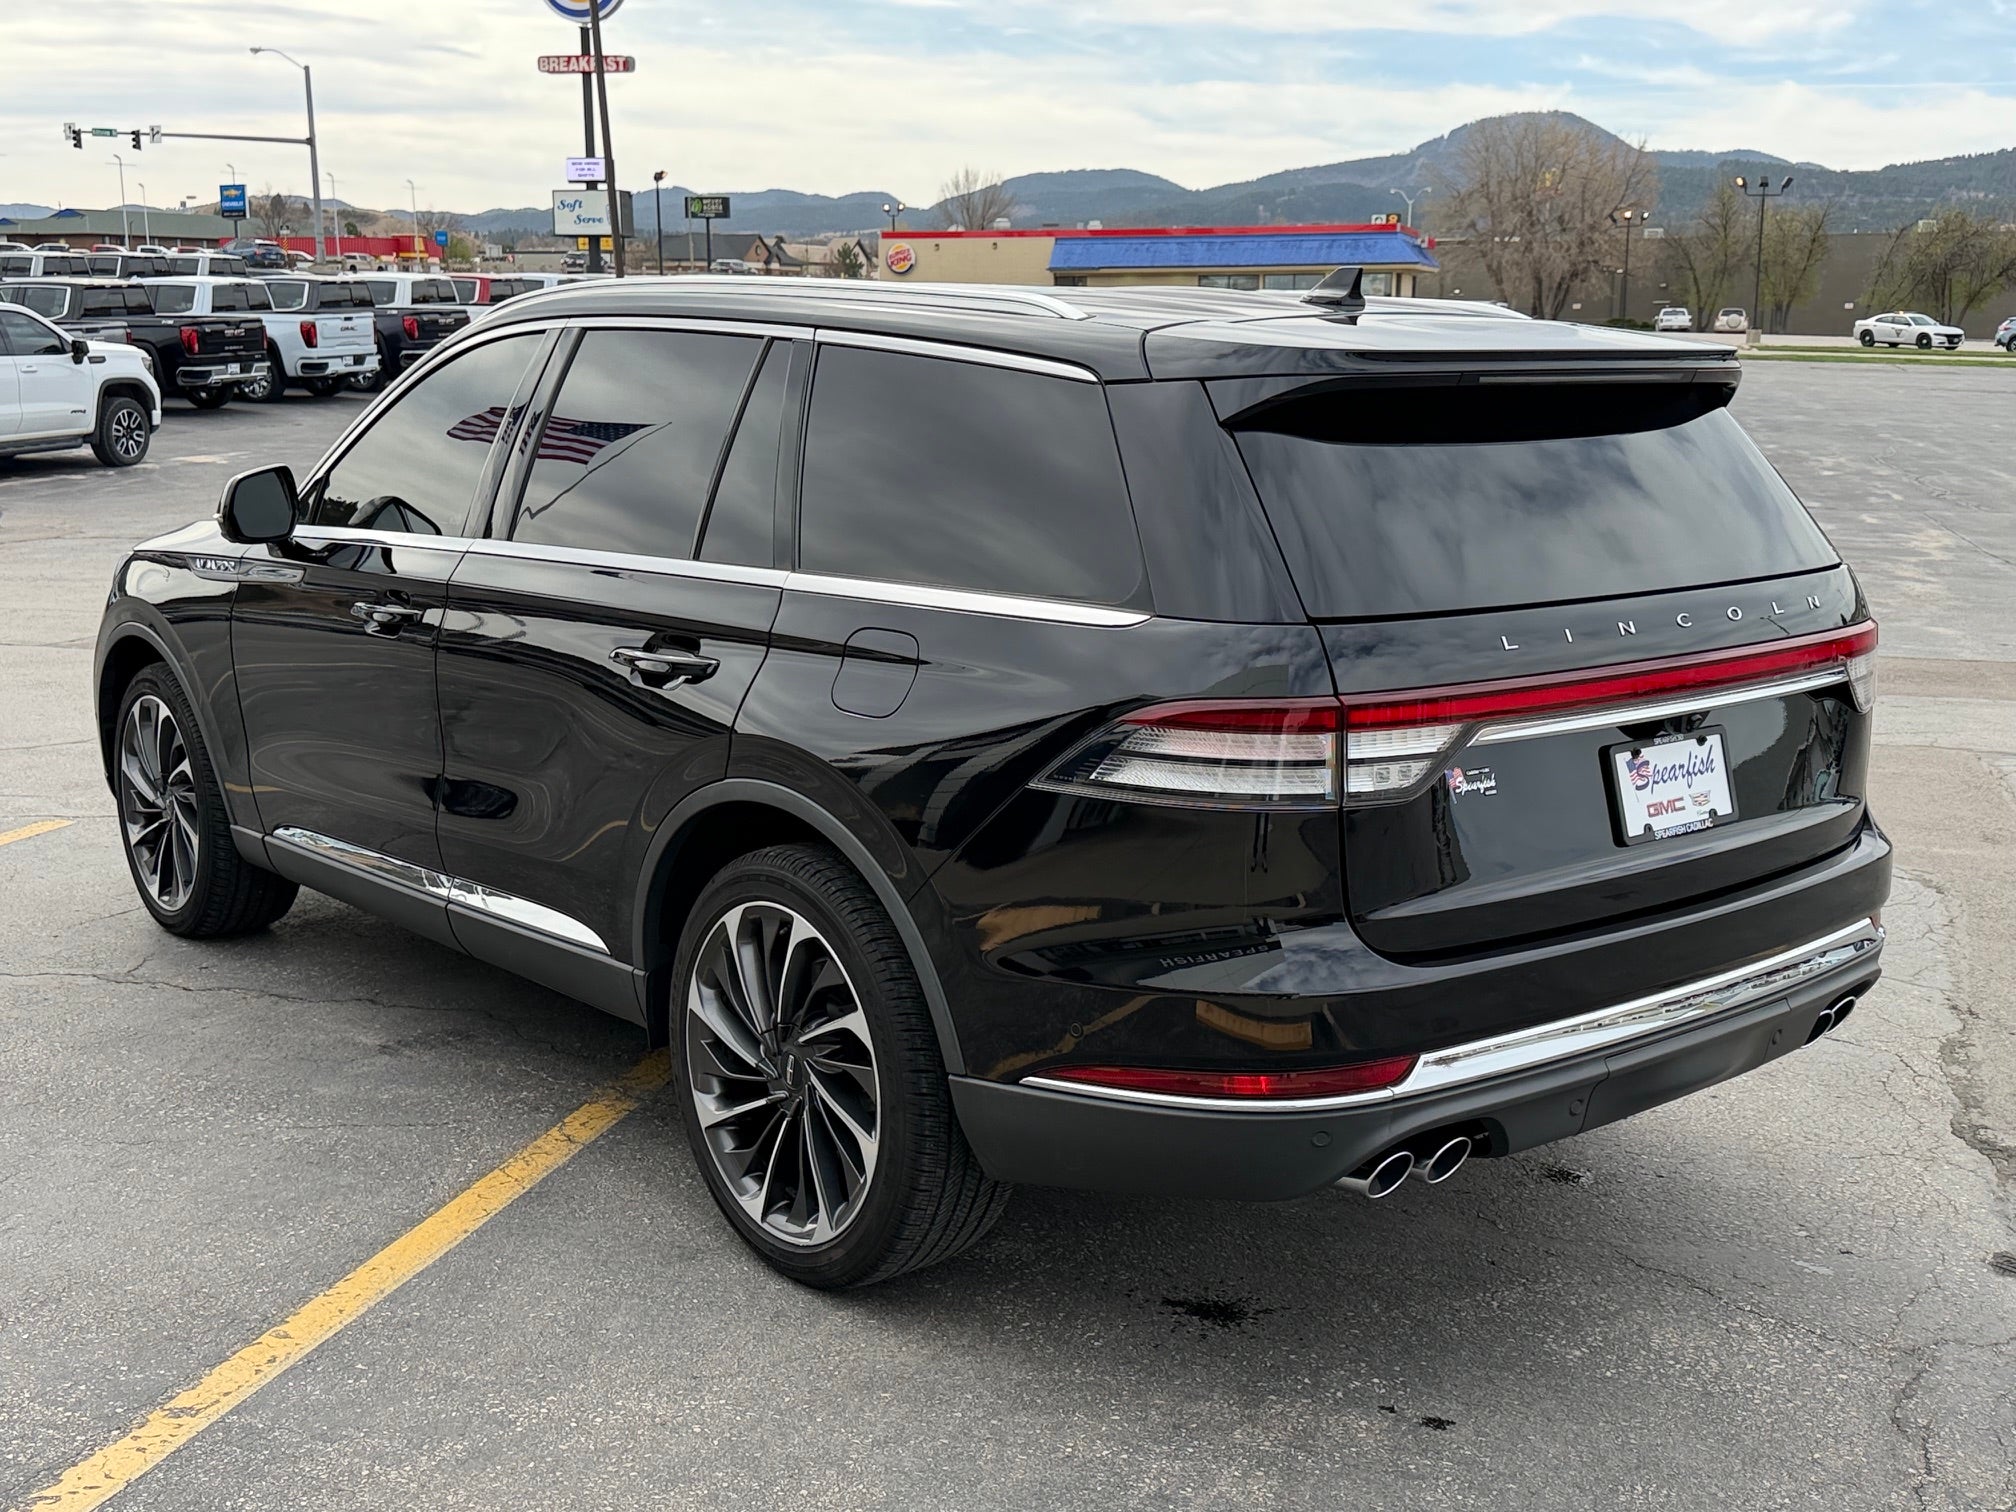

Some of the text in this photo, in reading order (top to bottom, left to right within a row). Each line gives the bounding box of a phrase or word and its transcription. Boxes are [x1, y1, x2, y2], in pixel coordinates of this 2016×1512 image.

[558, 199, 583, 213] Soft
[573, 214, 604, 225] Serve
[890, 254, 912, 267] KING
[1501, 594, 1821, 652] LINCOLN
[1635, 744, 1716, 795] Spearfish
[1455, 772, 1497, 796] Spearfish
[1646, 796, 1686, 818] GMC
[1654, 818, 1714, 841] SPEARFISH CADILLAC
